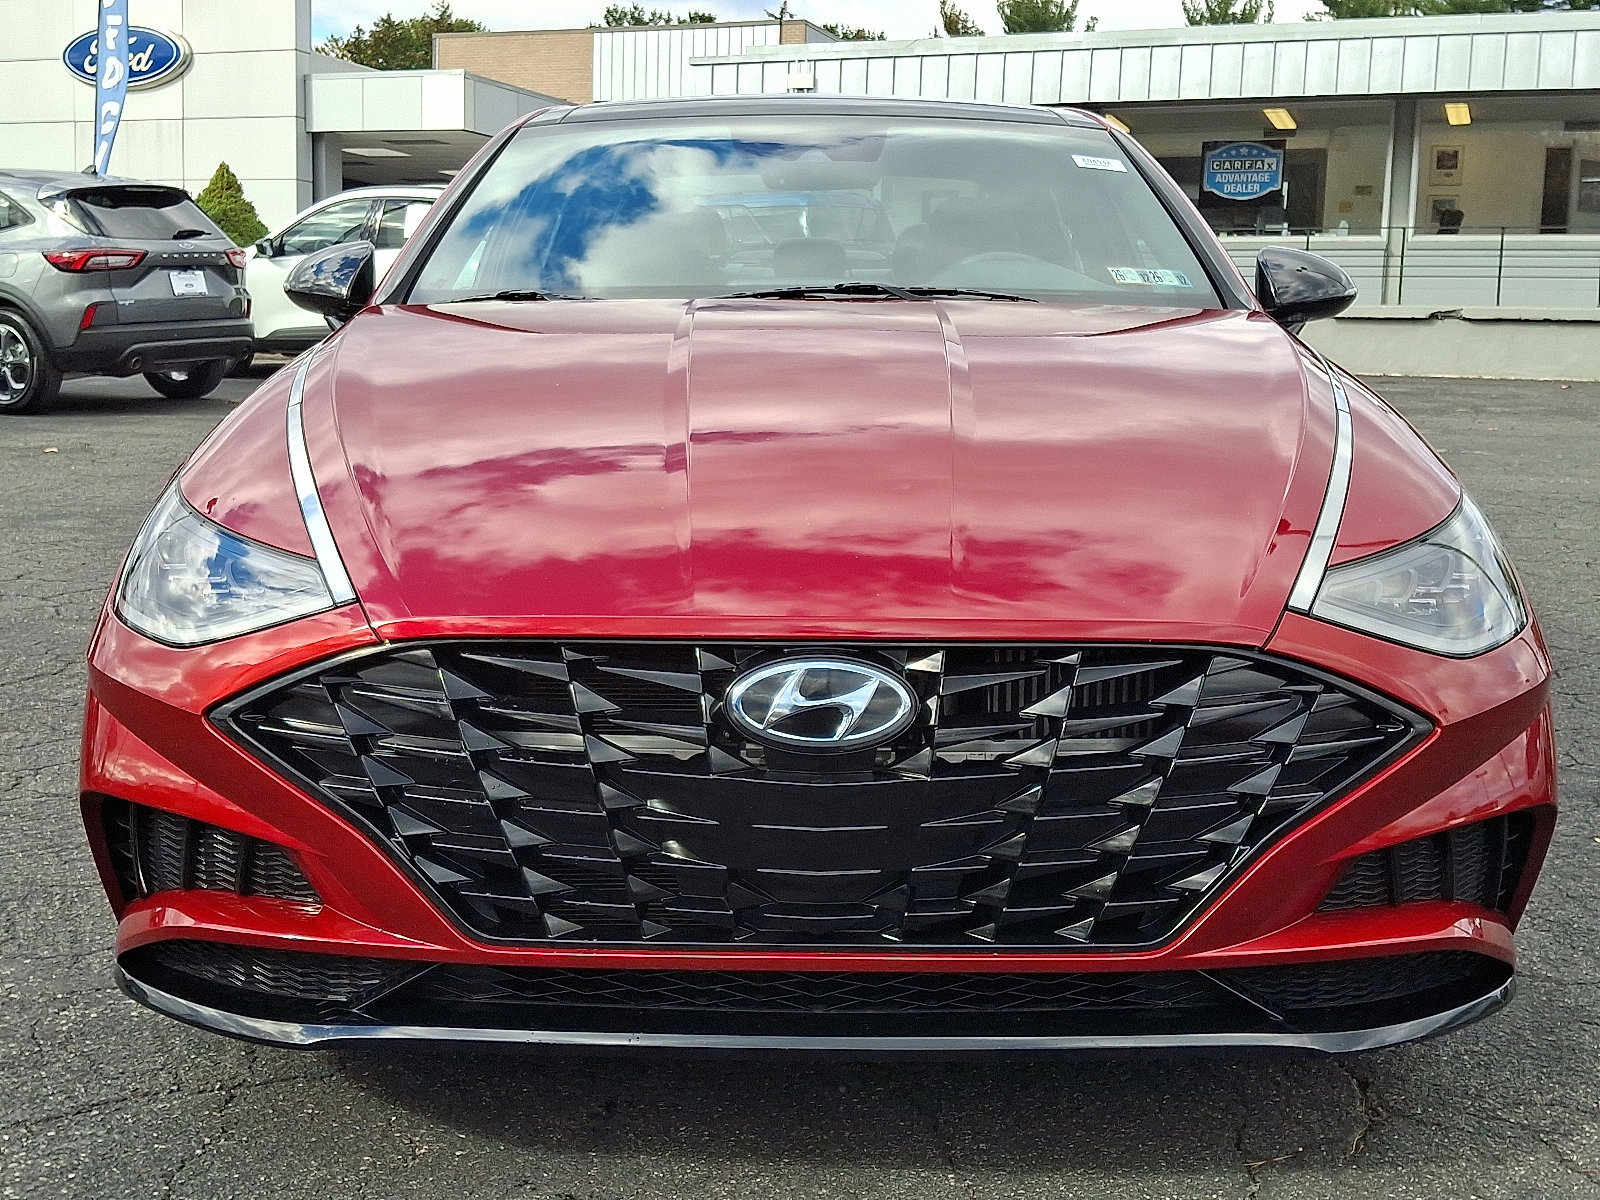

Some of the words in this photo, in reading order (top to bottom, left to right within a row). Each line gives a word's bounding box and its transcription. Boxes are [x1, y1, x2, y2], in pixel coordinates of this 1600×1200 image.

[1212, 160, 1275, 171] CARFAX
[1215, 173, 1271, 183] ADVANTAGE
[1224, 183, 1260, 193] DEALER
